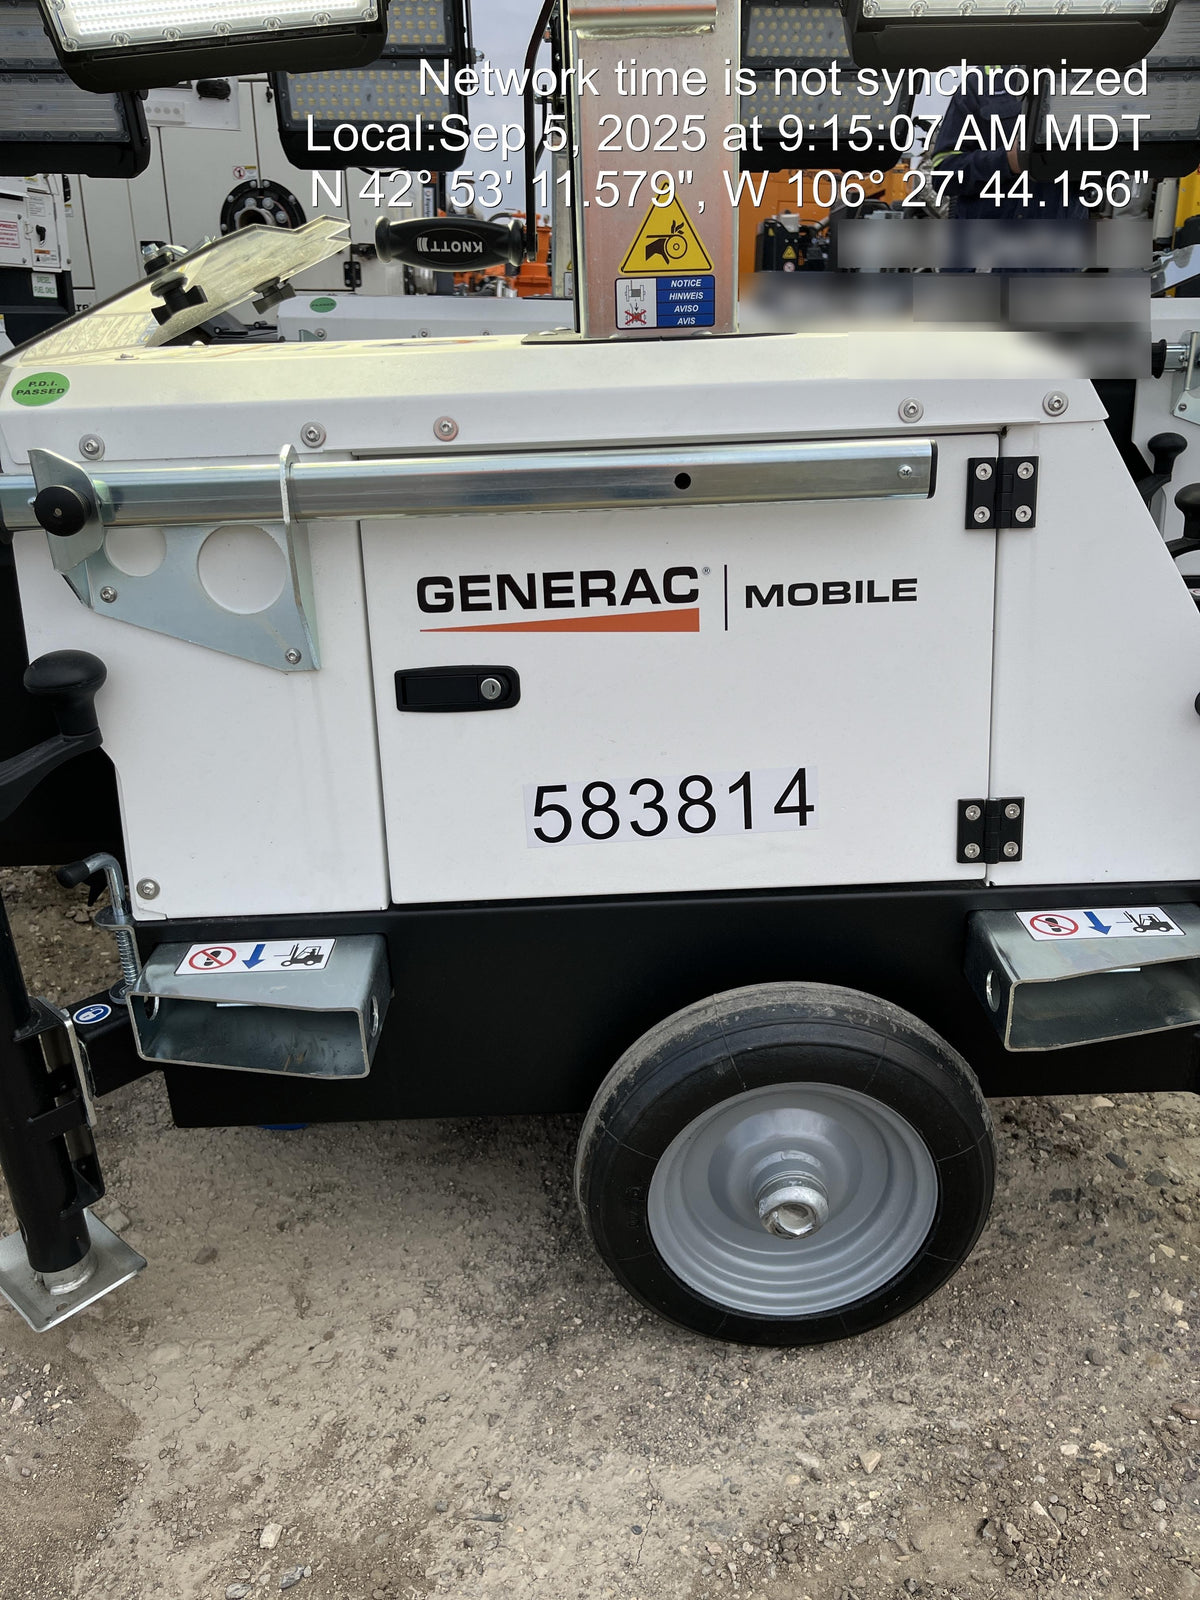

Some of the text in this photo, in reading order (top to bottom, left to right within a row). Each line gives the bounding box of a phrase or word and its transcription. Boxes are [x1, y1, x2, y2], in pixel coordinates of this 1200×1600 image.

[430, 240, 483, 253] KNOTT
[670, 279, 702, 287] NOTICE
[669, 291, 704, 301] HINWEIS
[674, 304, 699, 313] AVISO
[677, 317, 696, 325] AVIS
[28, 380, 58, 388] P.D.I.
[15, 388, 65, 396] PASSED
[416, 566, 918, 614] GENERAC MOBILE
[532, 767, 816, 845] 583814
